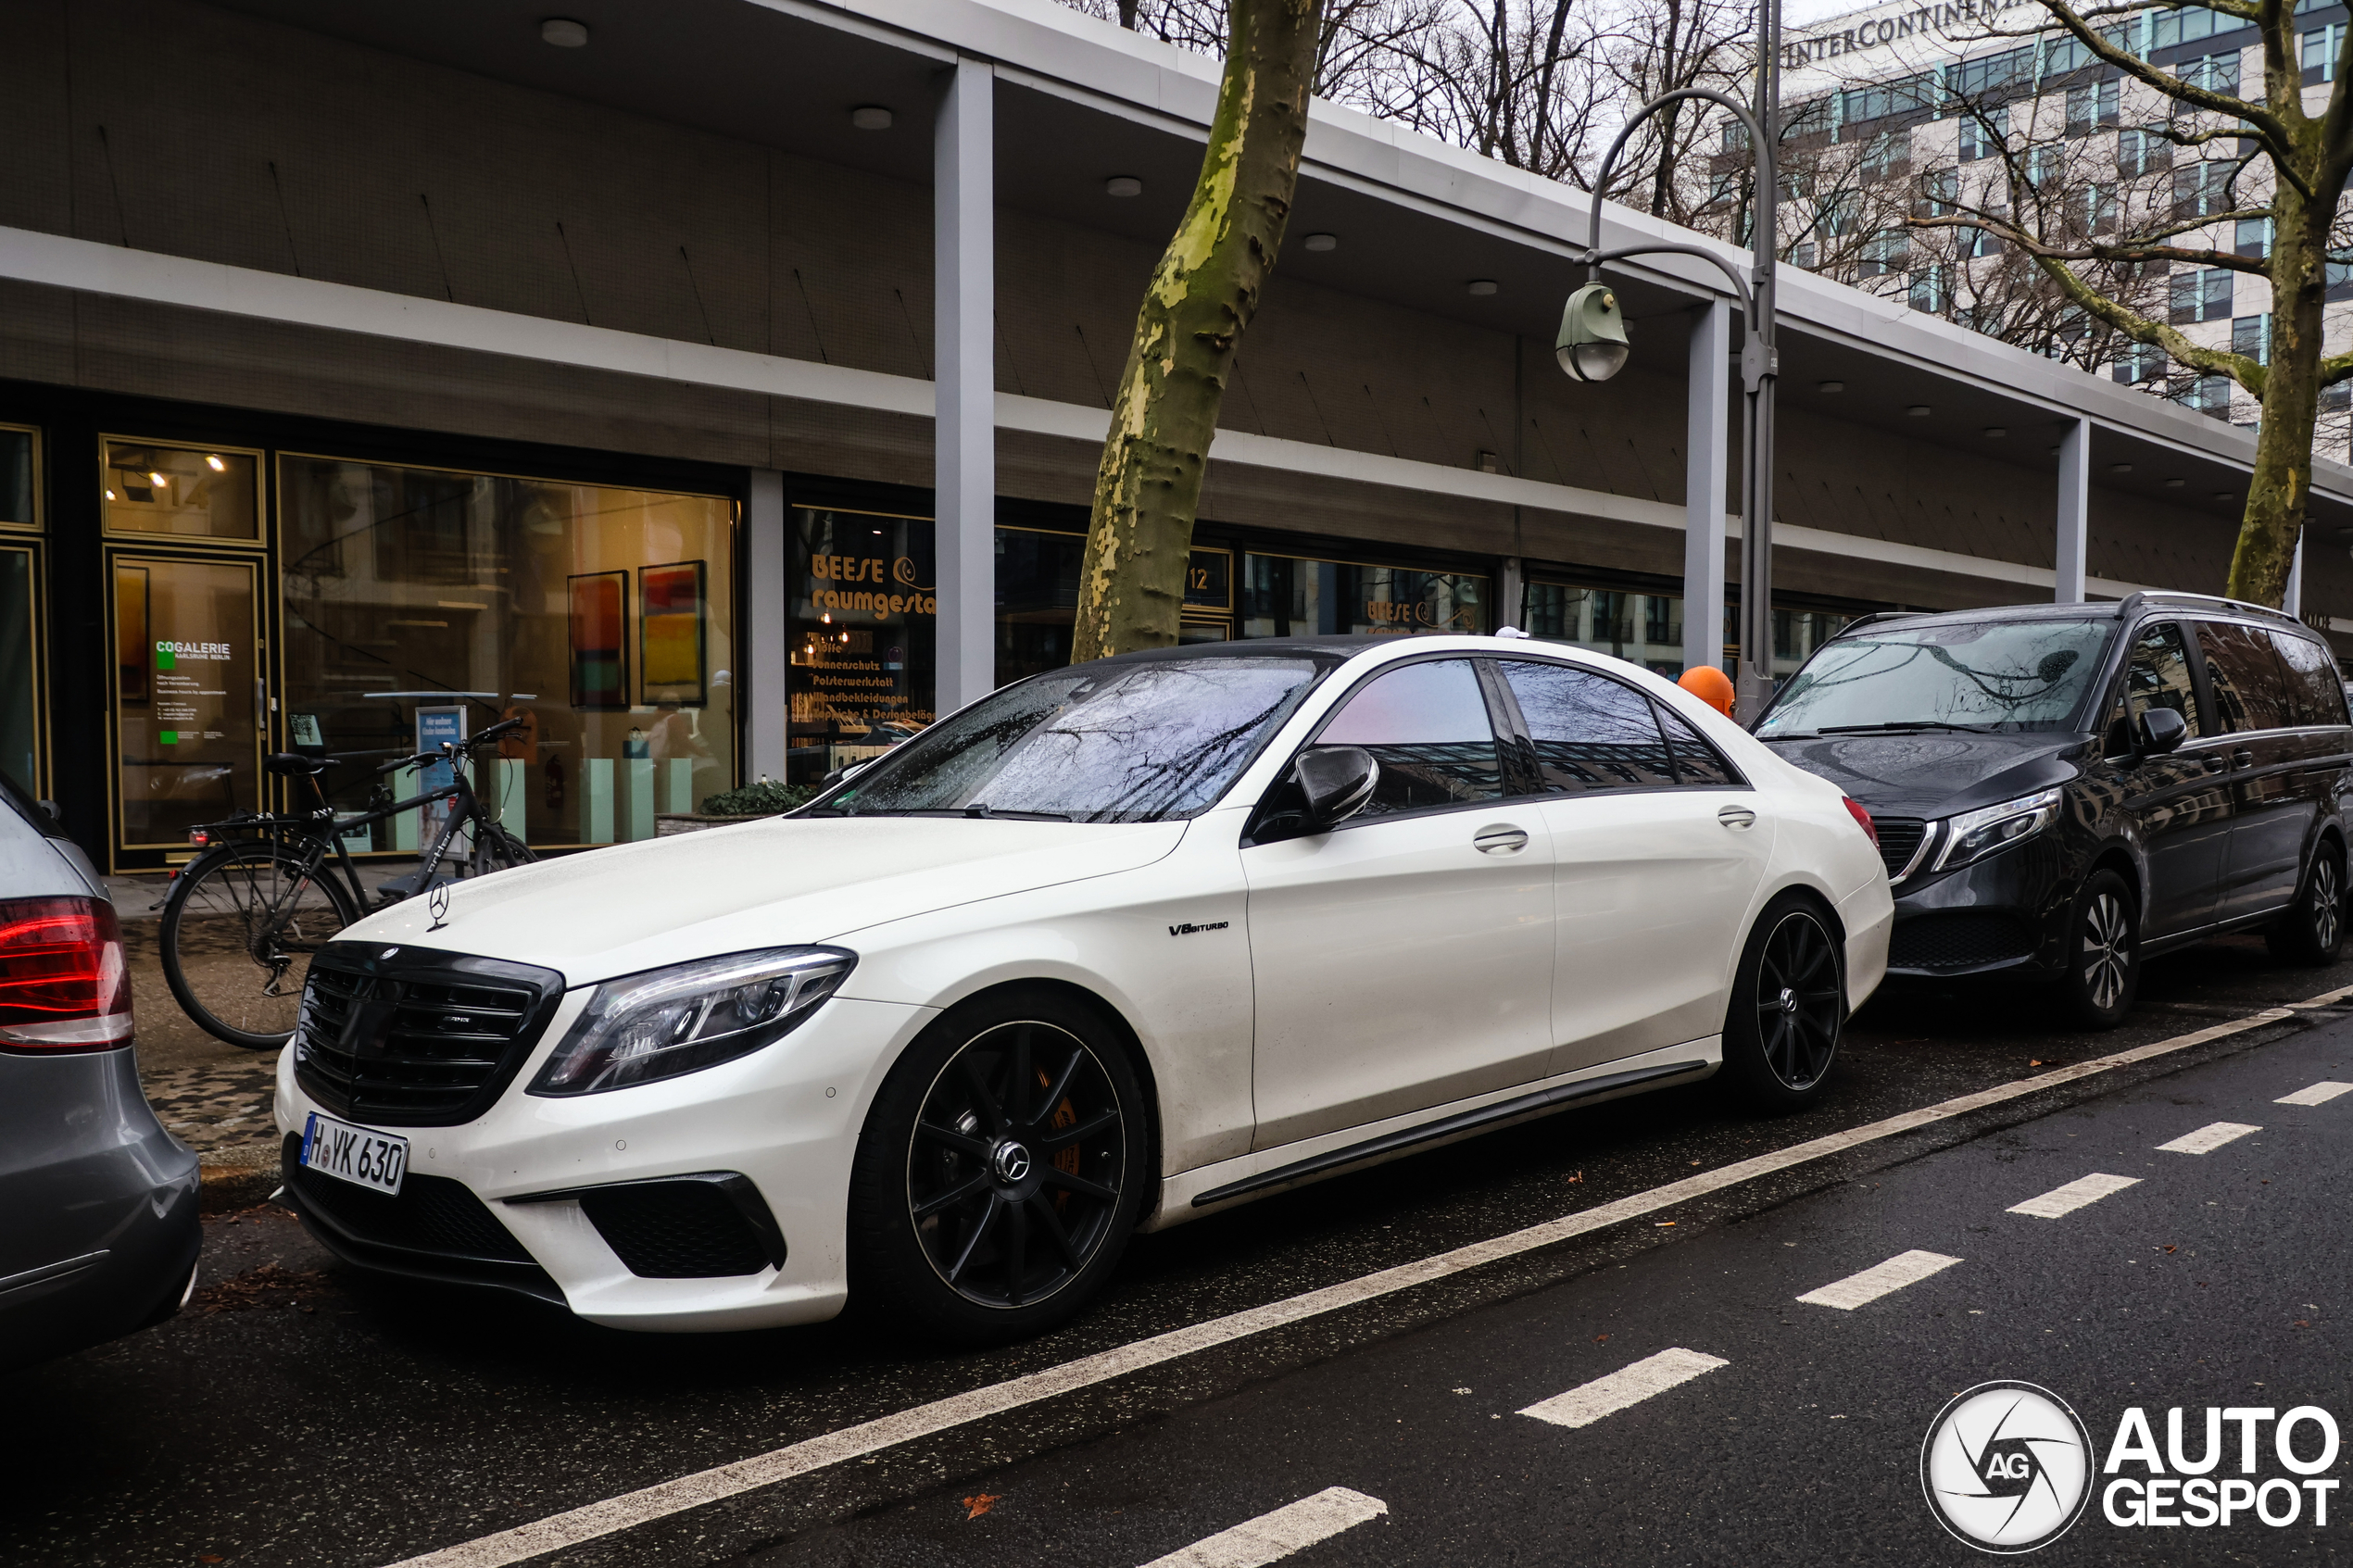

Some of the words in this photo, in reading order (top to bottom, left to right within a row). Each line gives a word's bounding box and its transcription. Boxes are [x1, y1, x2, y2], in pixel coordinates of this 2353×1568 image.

[1787, 0, 2033, 69] INTERCONTINEN
[169, 475, 209, 509] 14
[812, 554, 884, 583] BEESE
[1189, 567, 1208, 590] 12
[812, 589, 936, 620] raumgesta
[1367, 600, 1410, 622] BEESE
[157, 641, 232, 654] COGALERIE
[812, 659, 881, 671] Sonnenschutz
[812, 674, 893, 687] Polsterwerkstatt
[812, 691, 909, 706] Wandbekleidungen
[862, 709, 869, 719] &
[1191, 922, 1229, 934] BITURBO
[309, 1121, 326, 1164] H
[332, 1127, 359, 1175] YK
[358, 1136, 402, 1186] 630
